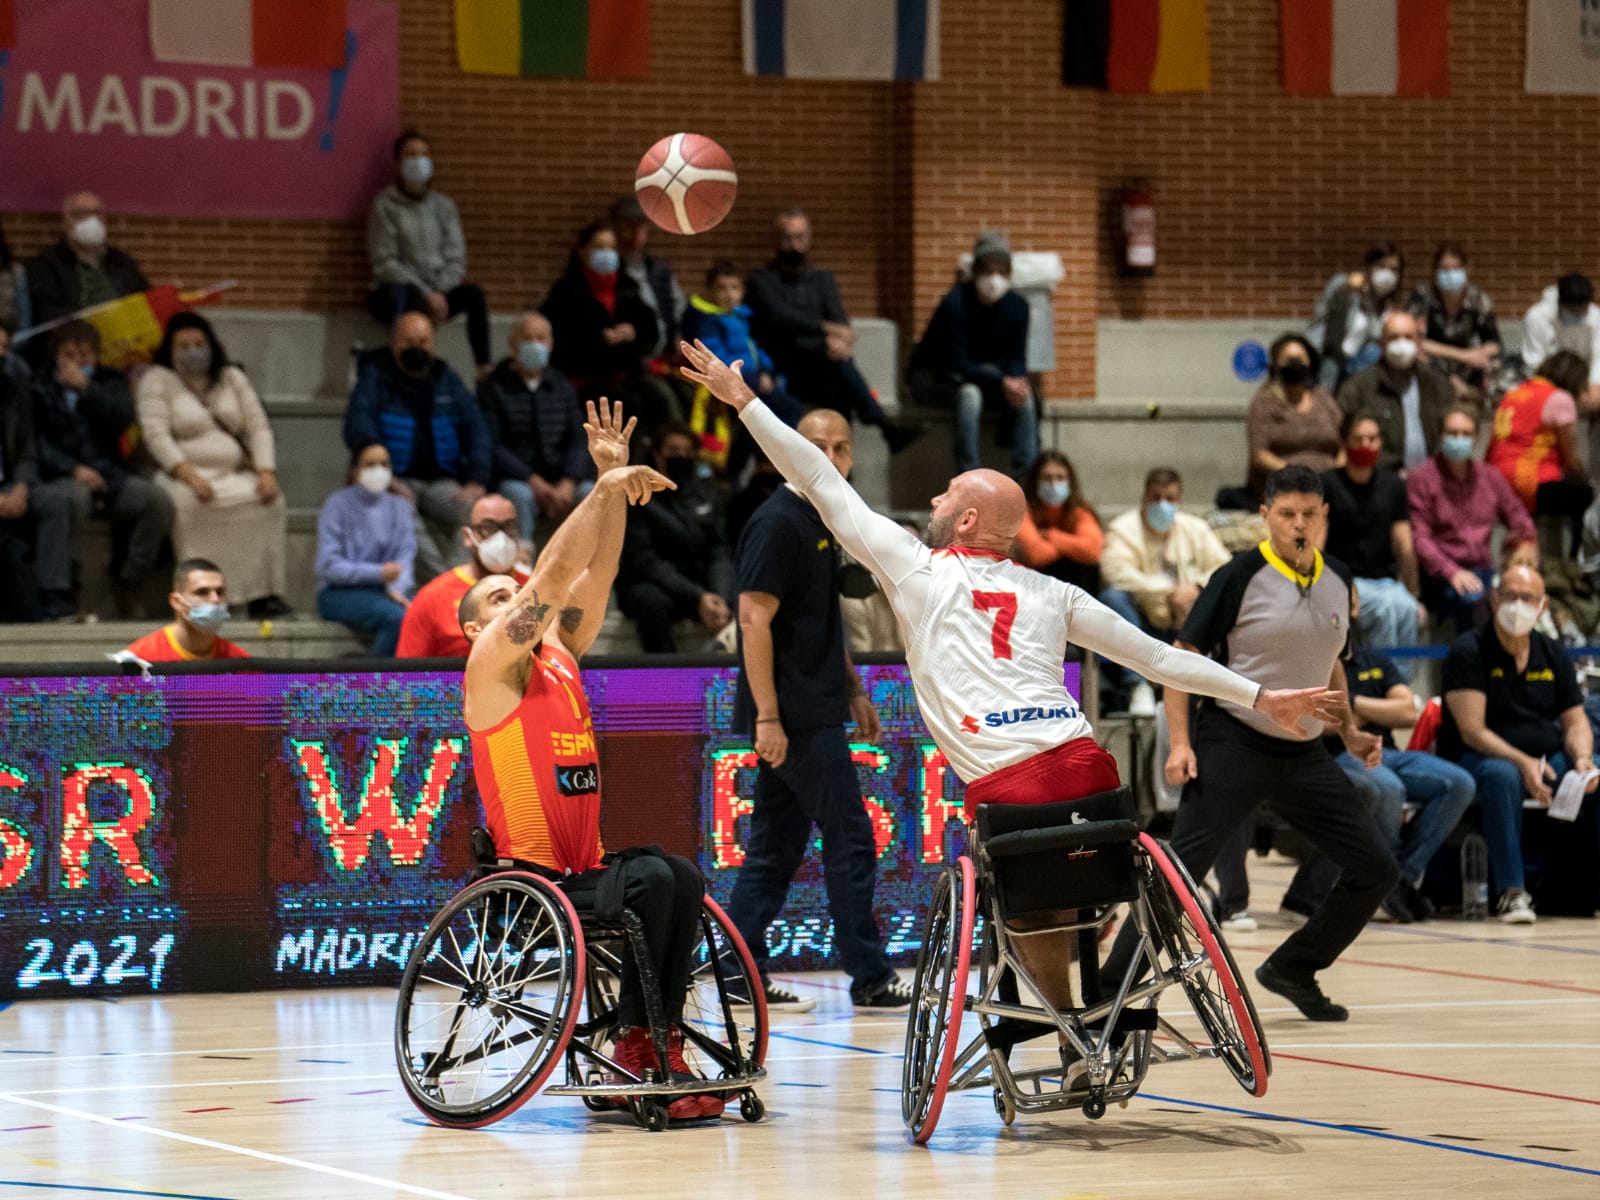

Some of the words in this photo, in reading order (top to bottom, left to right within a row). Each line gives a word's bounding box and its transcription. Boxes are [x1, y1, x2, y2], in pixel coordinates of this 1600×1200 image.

[971, 588, 1018, 661] 7
[985, 706, 1077, 728] SUZUKI
[290, 736, 470, 870] W
[16, 934, 175, 990] 2021
